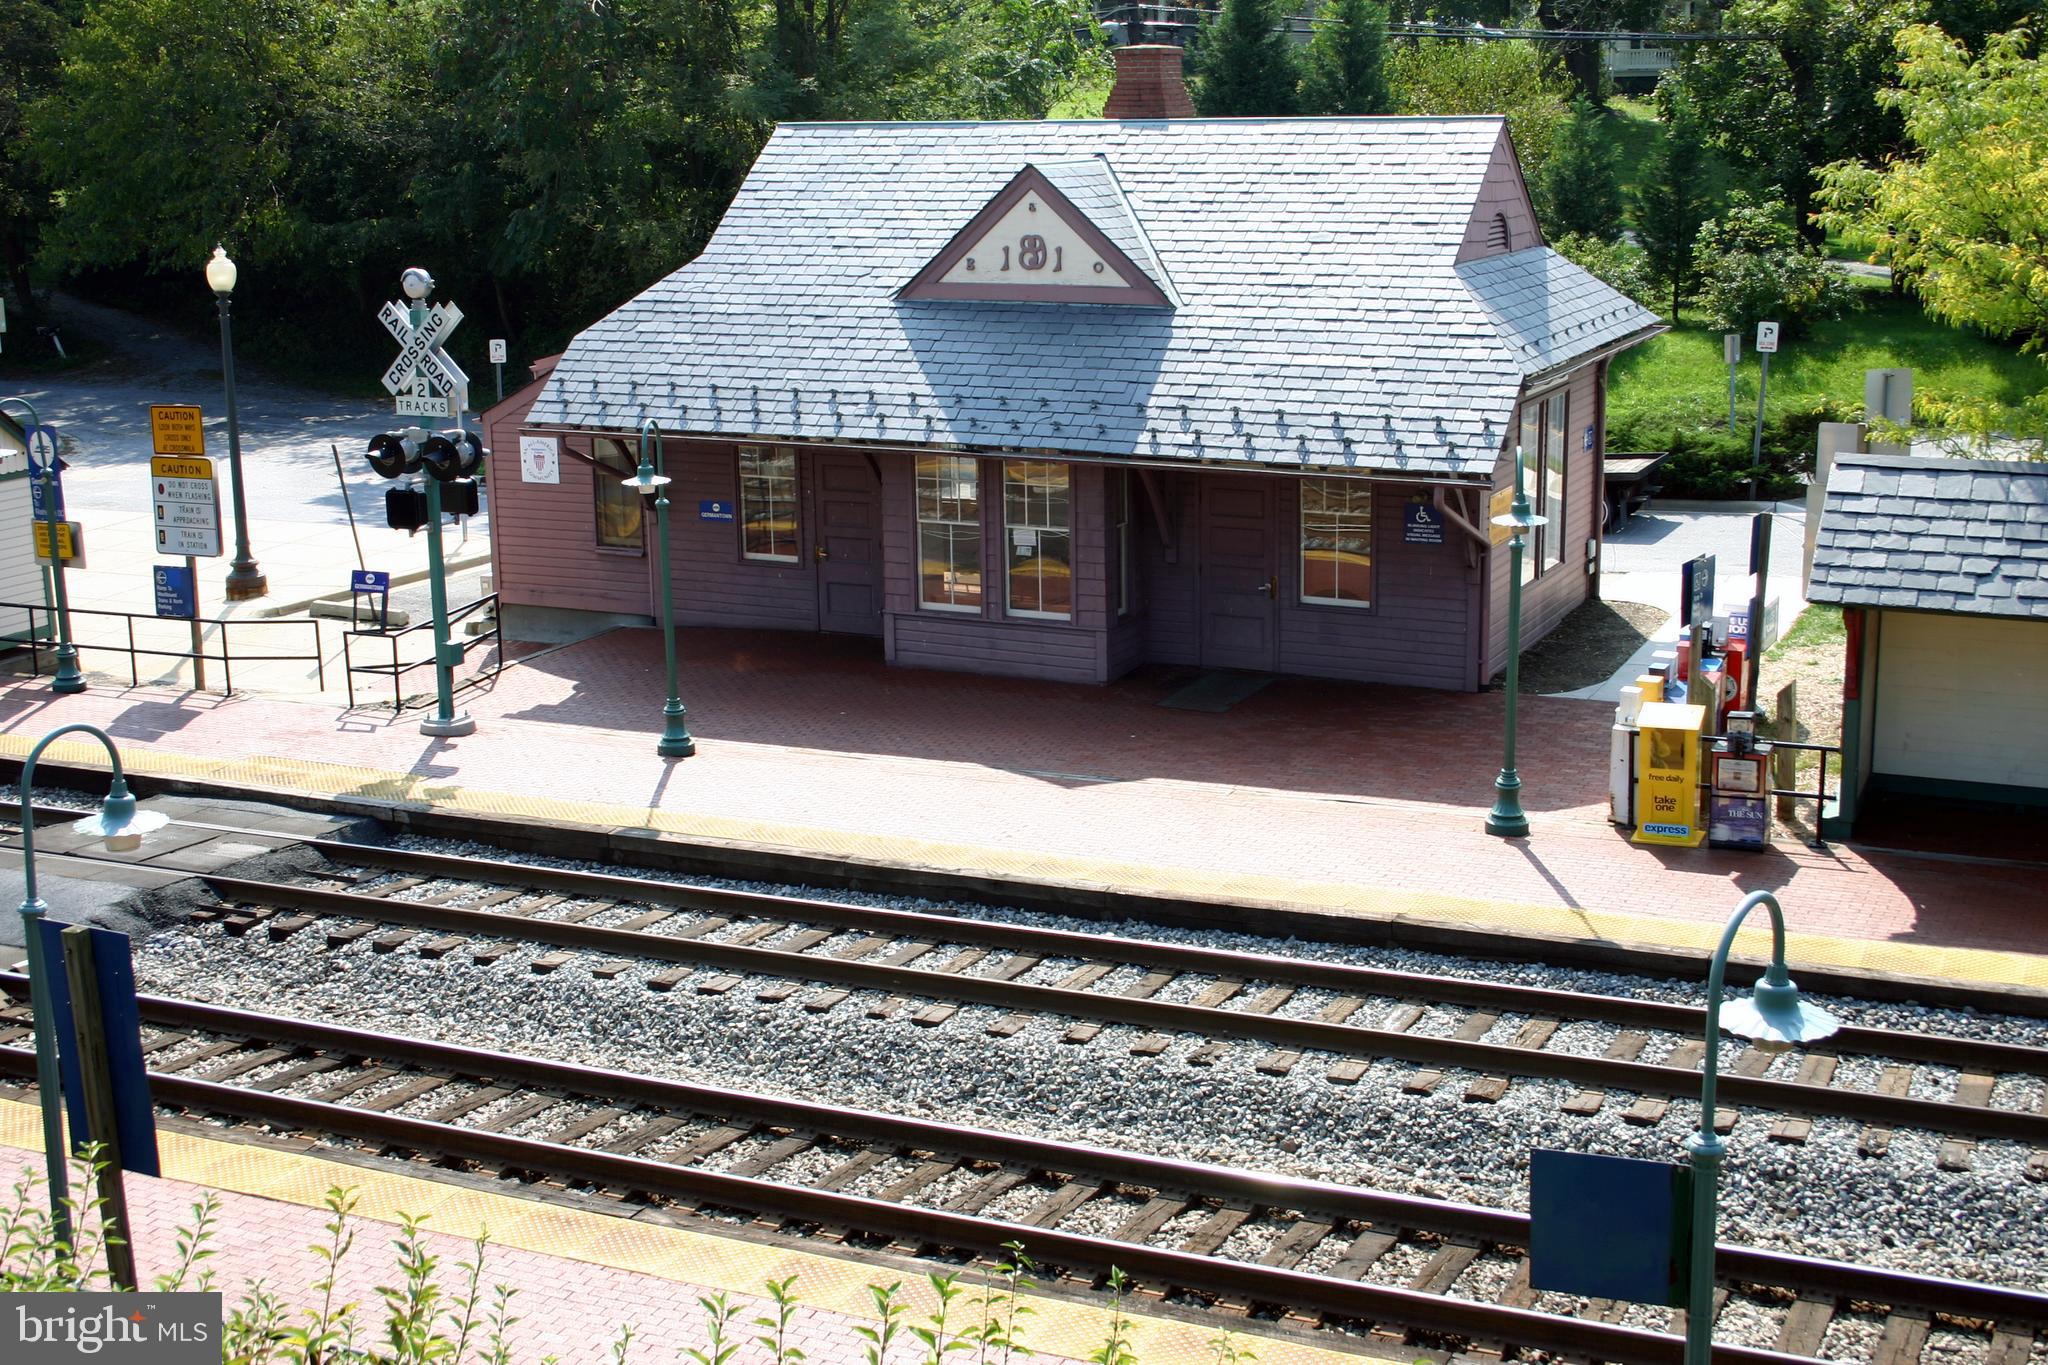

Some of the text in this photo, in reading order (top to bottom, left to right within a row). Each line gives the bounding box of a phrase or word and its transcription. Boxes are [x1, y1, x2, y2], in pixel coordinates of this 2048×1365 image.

[381, 307, 410, 346] RAIL
[388, 312, 443, 386] CROSSING
[421, 354, 454, 396] ROAD
[418, 384, 426, 398] 2
[398, 400, 446, 412] TRACKS
[158, 411, 194, 420] CAUTION
[161, 464, 201, 474] CAUTION
[191, 482, 208, 490] CROSS
[185, 492, 212, 500] FLASHING
[179, 506, 194, 514] TRAIN
[173, 516, 210, 525] APPROACHING
[181, 530, 196, 538] TRAIN
[1648, 774, 1684, 784] free daily
[1654, 796, 1676, 805] take
[1655, 804, 1675, 812] one
[1644, 824, 1687, 834] express
